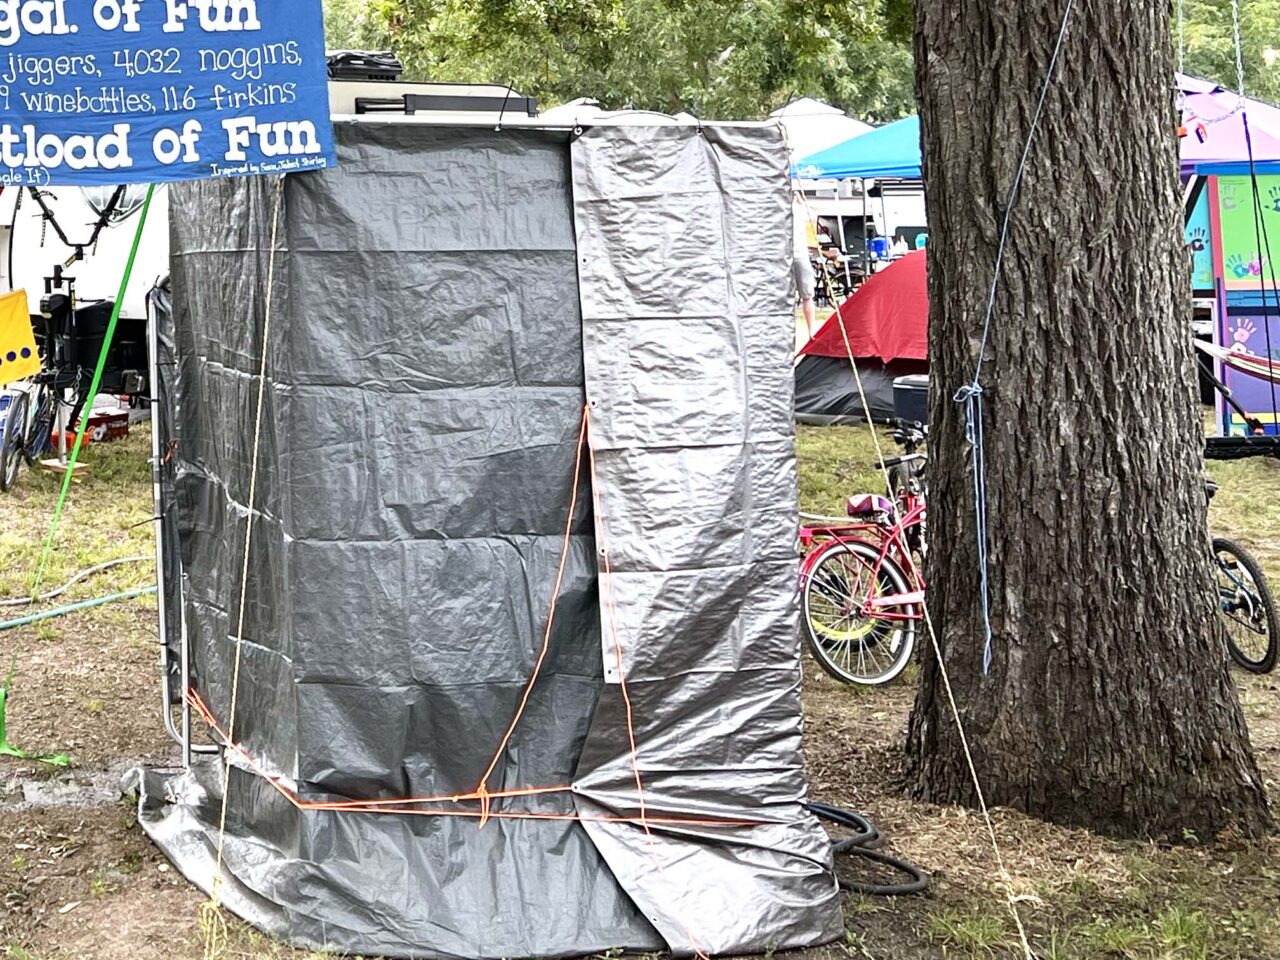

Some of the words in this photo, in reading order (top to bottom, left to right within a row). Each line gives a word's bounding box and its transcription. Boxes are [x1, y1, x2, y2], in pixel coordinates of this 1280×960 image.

[2, 52, 102, 86] jiggers,
[198, 41, 302, 80] noggins,
[209, 82, 297, 111] firkins
[153, 119, 202, 164] of
[221, 116, 321, 161] Fun
